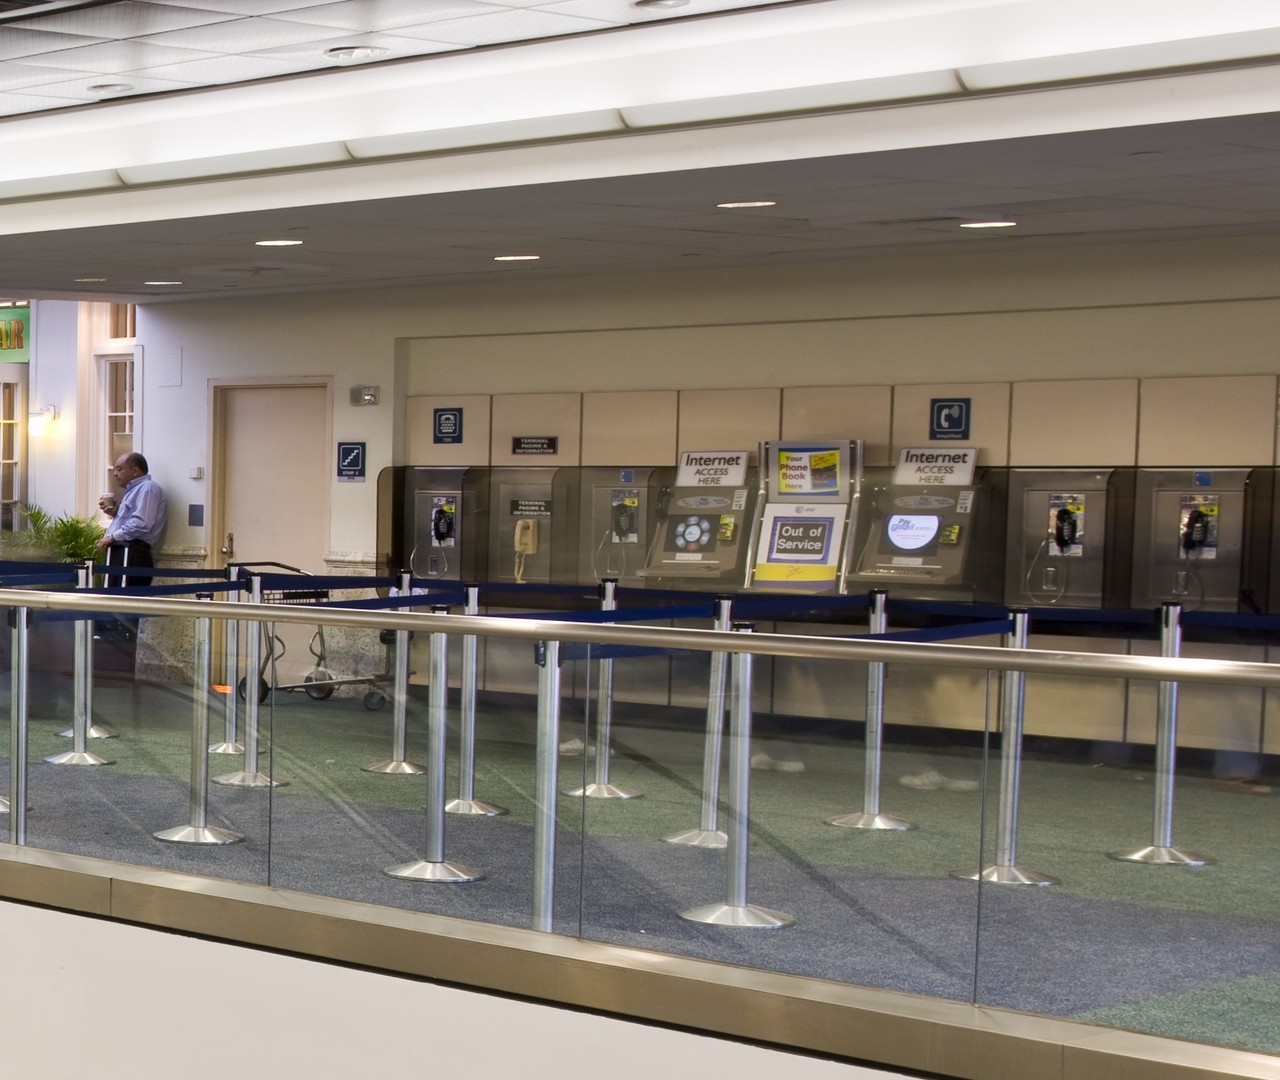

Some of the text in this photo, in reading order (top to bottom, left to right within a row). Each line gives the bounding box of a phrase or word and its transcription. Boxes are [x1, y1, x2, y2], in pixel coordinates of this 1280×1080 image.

[686, 455, 741, 467] Internet
[905, 450, 968, 463] Internet
[694, 468, 729, 476] ACCESS
[915, 466, 954, 474] ACCESS
[698, 477, 721, 485] HERE
[919, 476, 946, 484] HERE
[782, 527, 823, 537] Out of
[778, 539, 822, 550] Service
